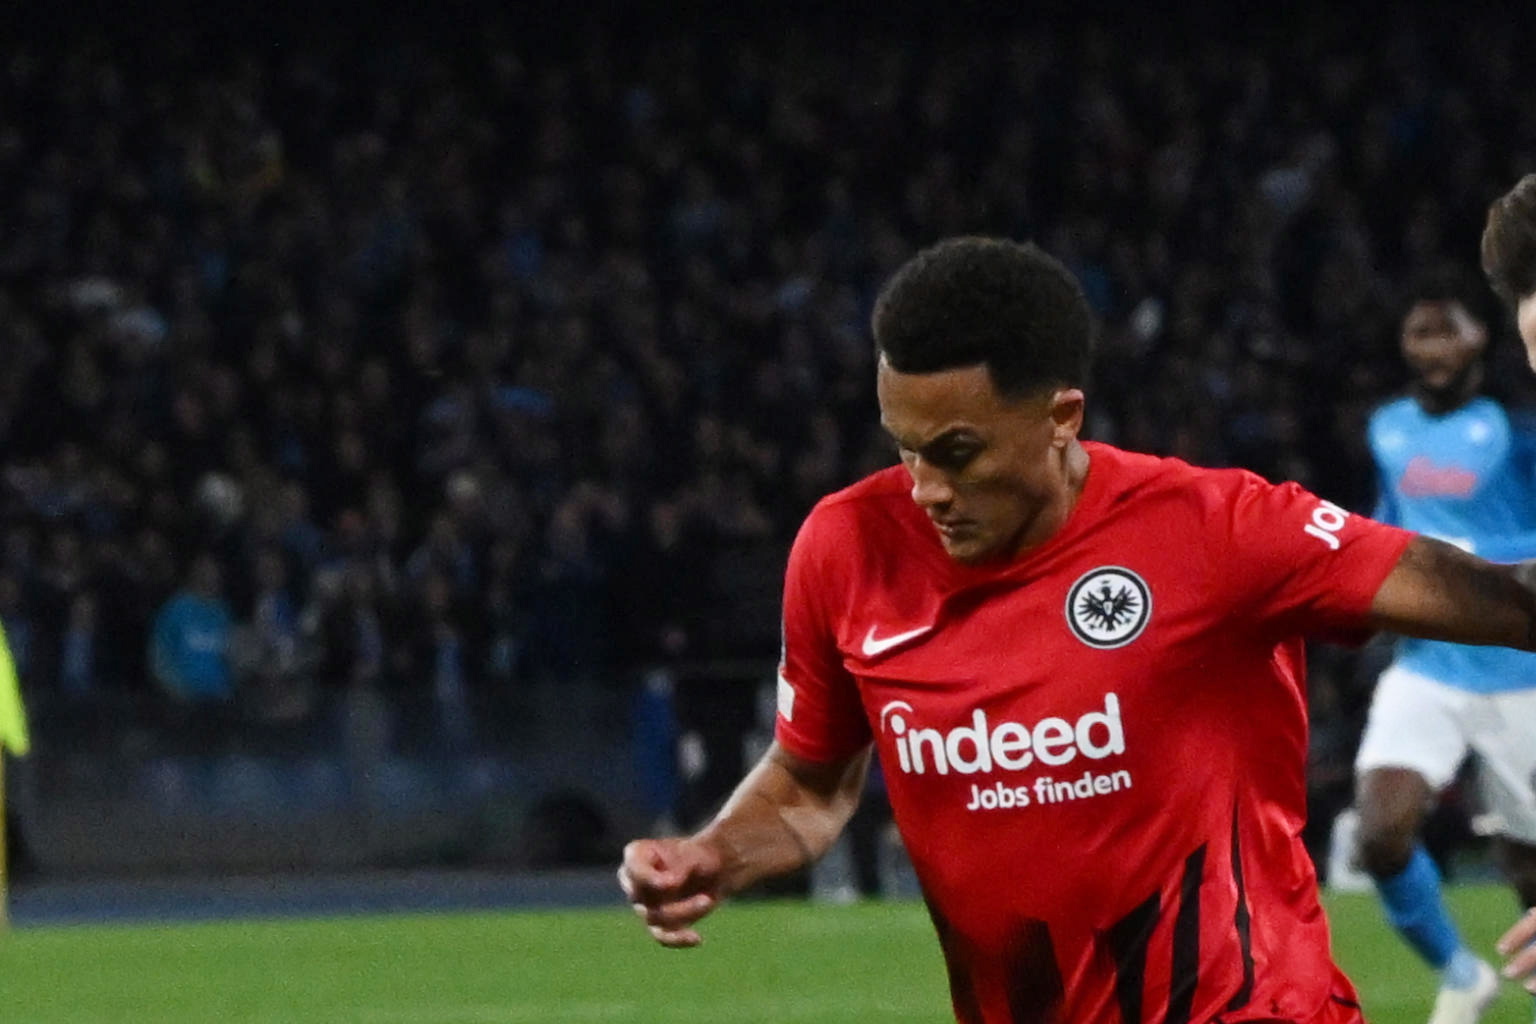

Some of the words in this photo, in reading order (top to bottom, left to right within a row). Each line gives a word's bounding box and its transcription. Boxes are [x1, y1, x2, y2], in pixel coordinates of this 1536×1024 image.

[880, 691, 1125, 776] indeed
[966, 780, 1029, 811] Jobs
[1035, 768, 1132, 804] finden
